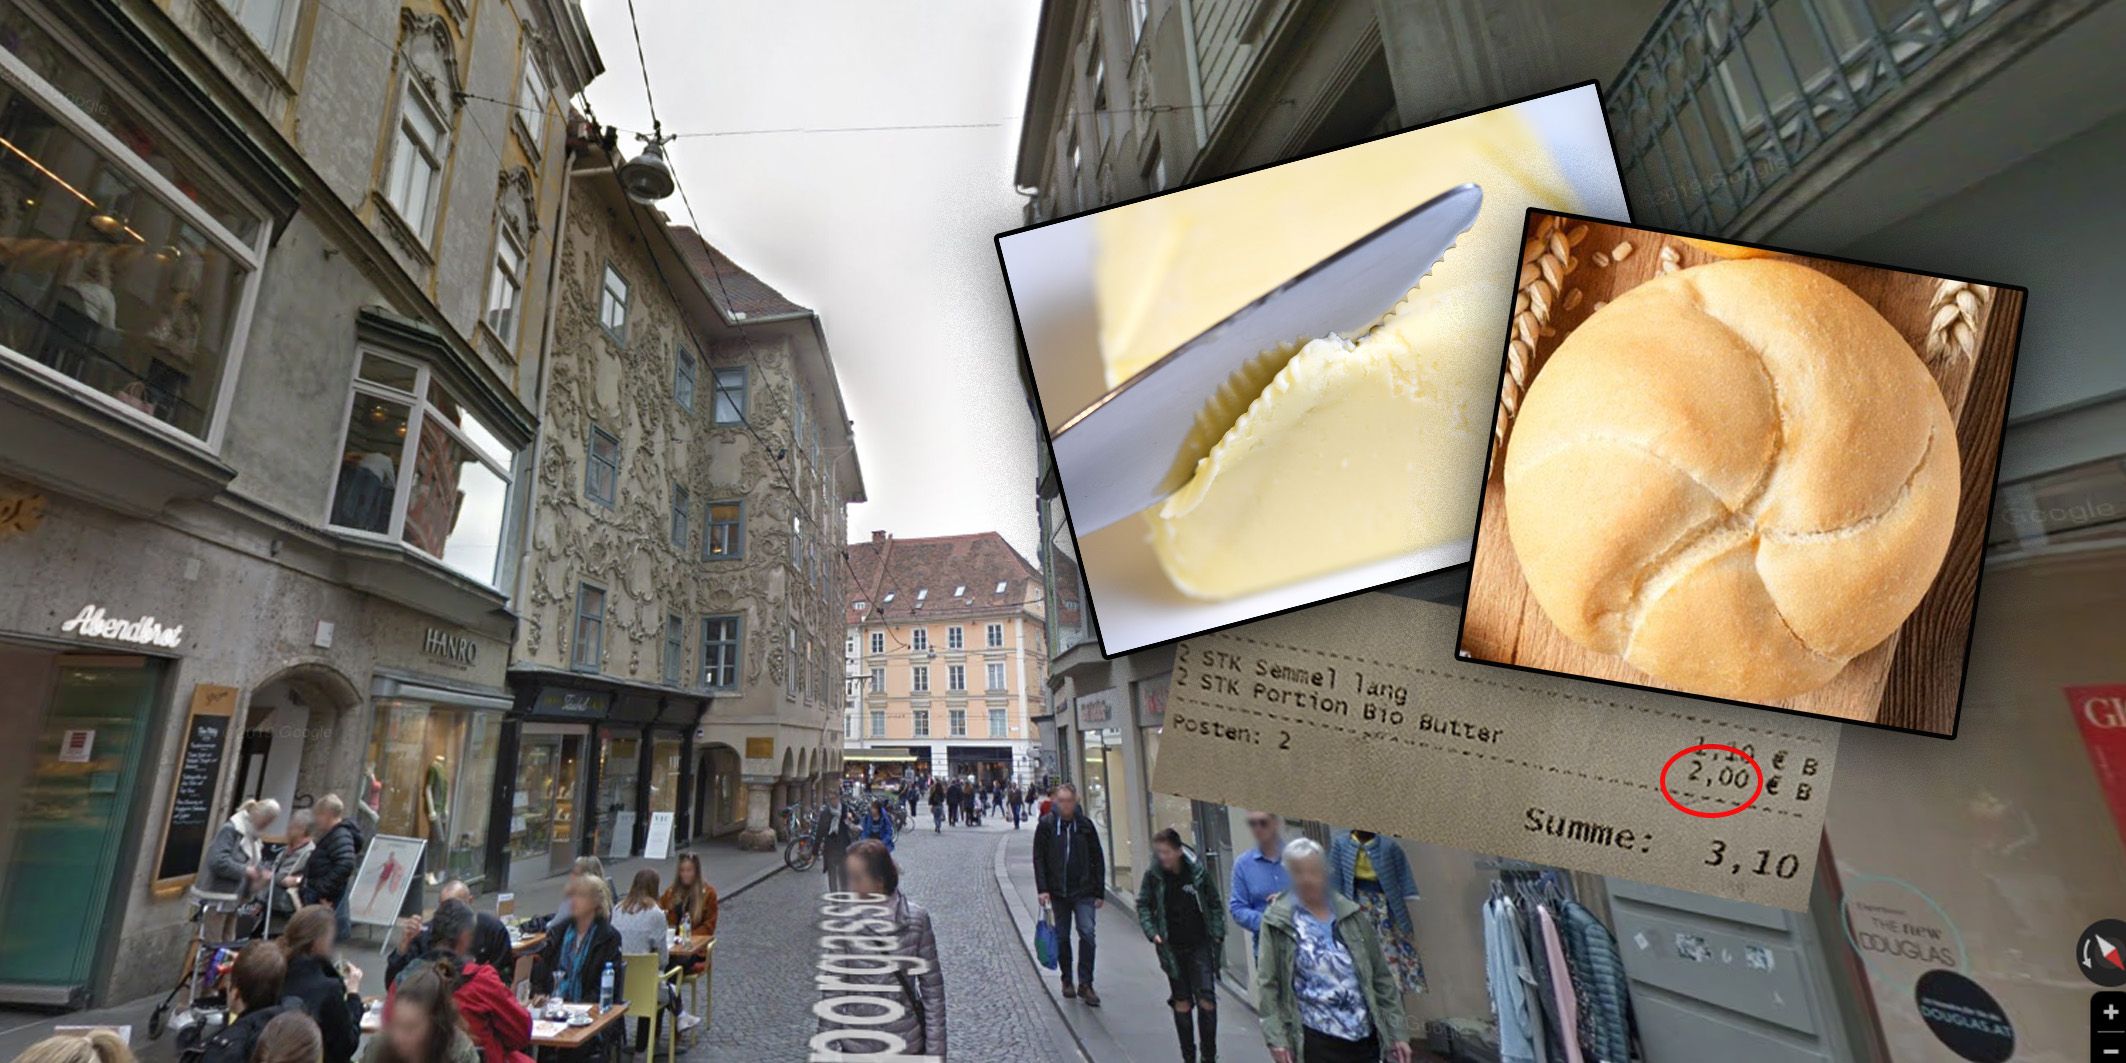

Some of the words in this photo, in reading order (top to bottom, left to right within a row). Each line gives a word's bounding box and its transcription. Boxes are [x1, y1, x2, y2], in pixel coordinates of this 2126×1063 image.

[61, 604, 183, 648] Abendbrot
[423, 627, 477, 663] HANRO
[1178, 643, 1189, 663] 2
[1201, 650, 1242, 673] STK
[1255, 659, 1336, 689] Semmel
[1355, 672, 1408, 706] lang
[1695, 736, 1755, 764] 1,10
[1772, 750, 1788, 770] €
[1802, 758, 1818, 776] B
[1173, 713, 1260, 745] Posten:
[1278, 731, 1291, 749] 2
[1177, 667, 1188, 686] 2
[1201, 674, 1240, 696] STK
[1253, 683, 1348, 716] Portion
[1364, 702, 1404, 725] Bio
[1419, 713, 1503, 743] Butter
[1688, 760, 1749, 788] 2,00
[1766, 774, 1781, 795] €
[1796, 783, 1812, 801] B
[1523, 806, 1653, 853] Summe:
[1704, 839, 1800, 880] 3,10
[1871, 917, 1899, 933] THE
[1902, 923, 1941, 940] new
[1859, 932, 1956, 967] DOUGLAS
